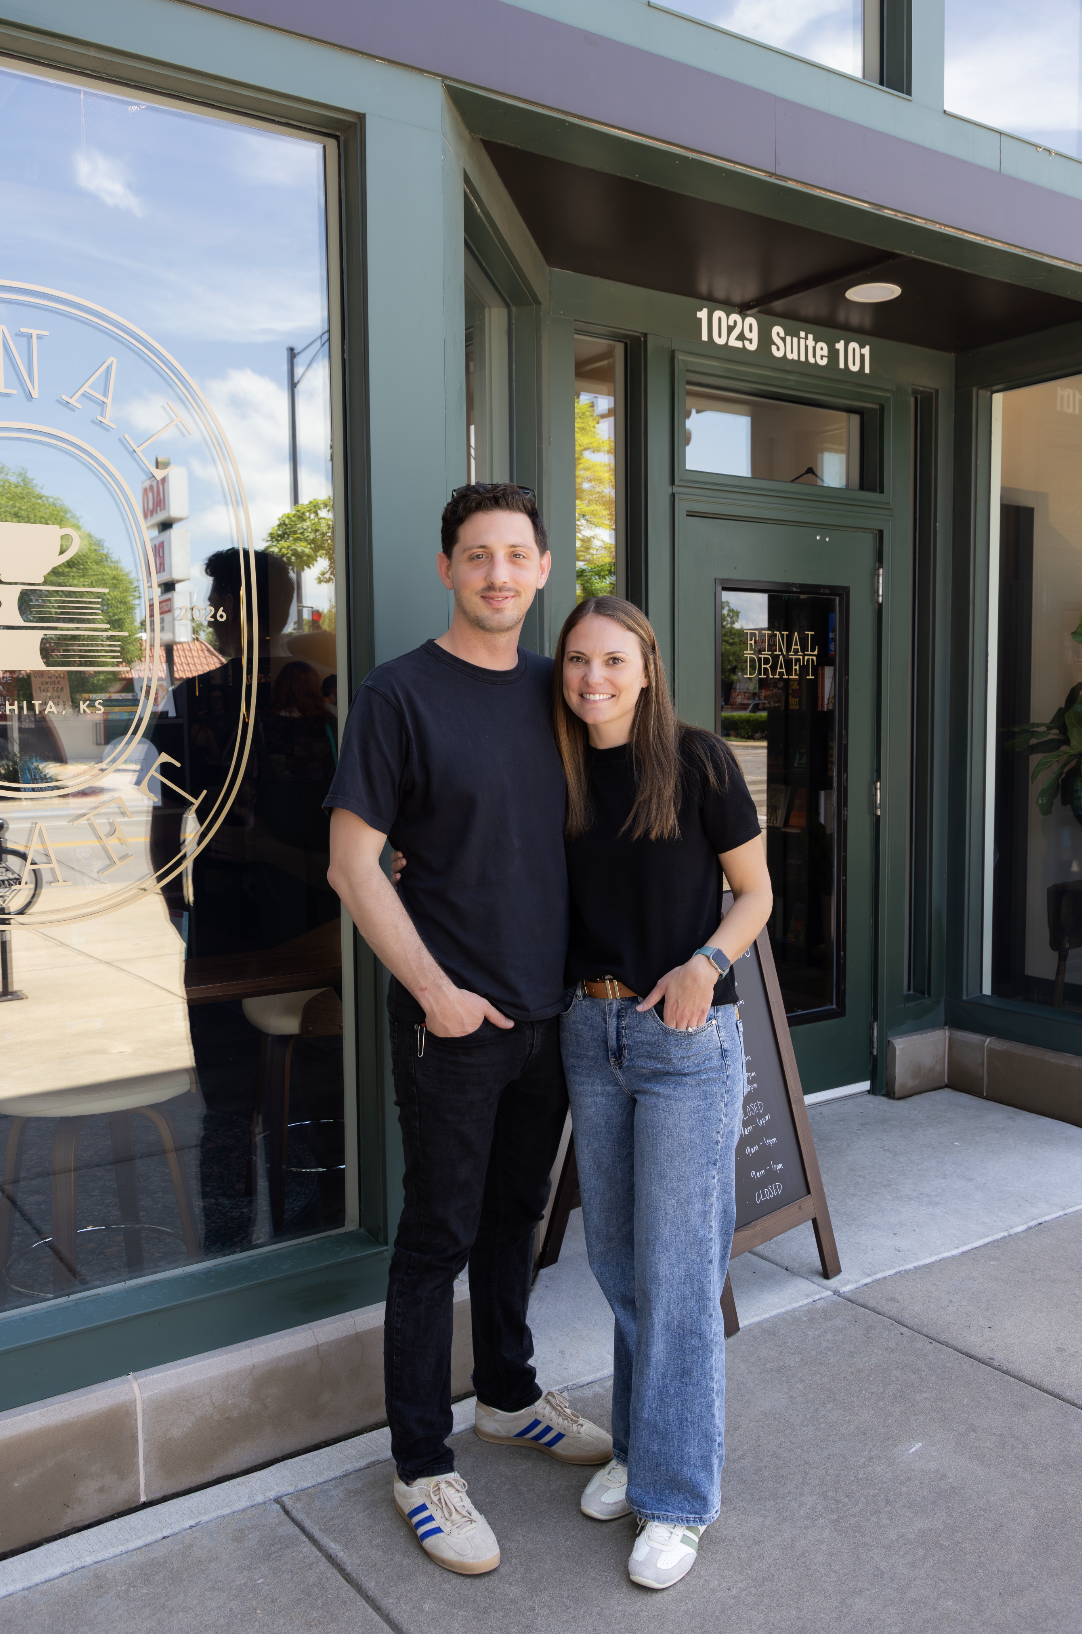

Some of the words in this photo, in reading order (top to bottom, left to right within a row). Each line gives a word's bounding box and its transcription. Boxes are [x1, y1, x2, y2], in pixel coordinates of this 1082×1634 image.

[696, 307, 759, 351] 1029
[771, 325, 829, 366] Suite
[834, 339, 870, 374] 101
[180, 605, 227, 622] 2026
[743, 629, 819, 655] FINAL
[743, 654, 817, 679] DRAFT
[0, 700, 66, 715] HITA,
[79, 699, 105, 714] KS
[743, 1100, 764, 1120] OSED
[755, 1182, 783, 1204] CLOSED
